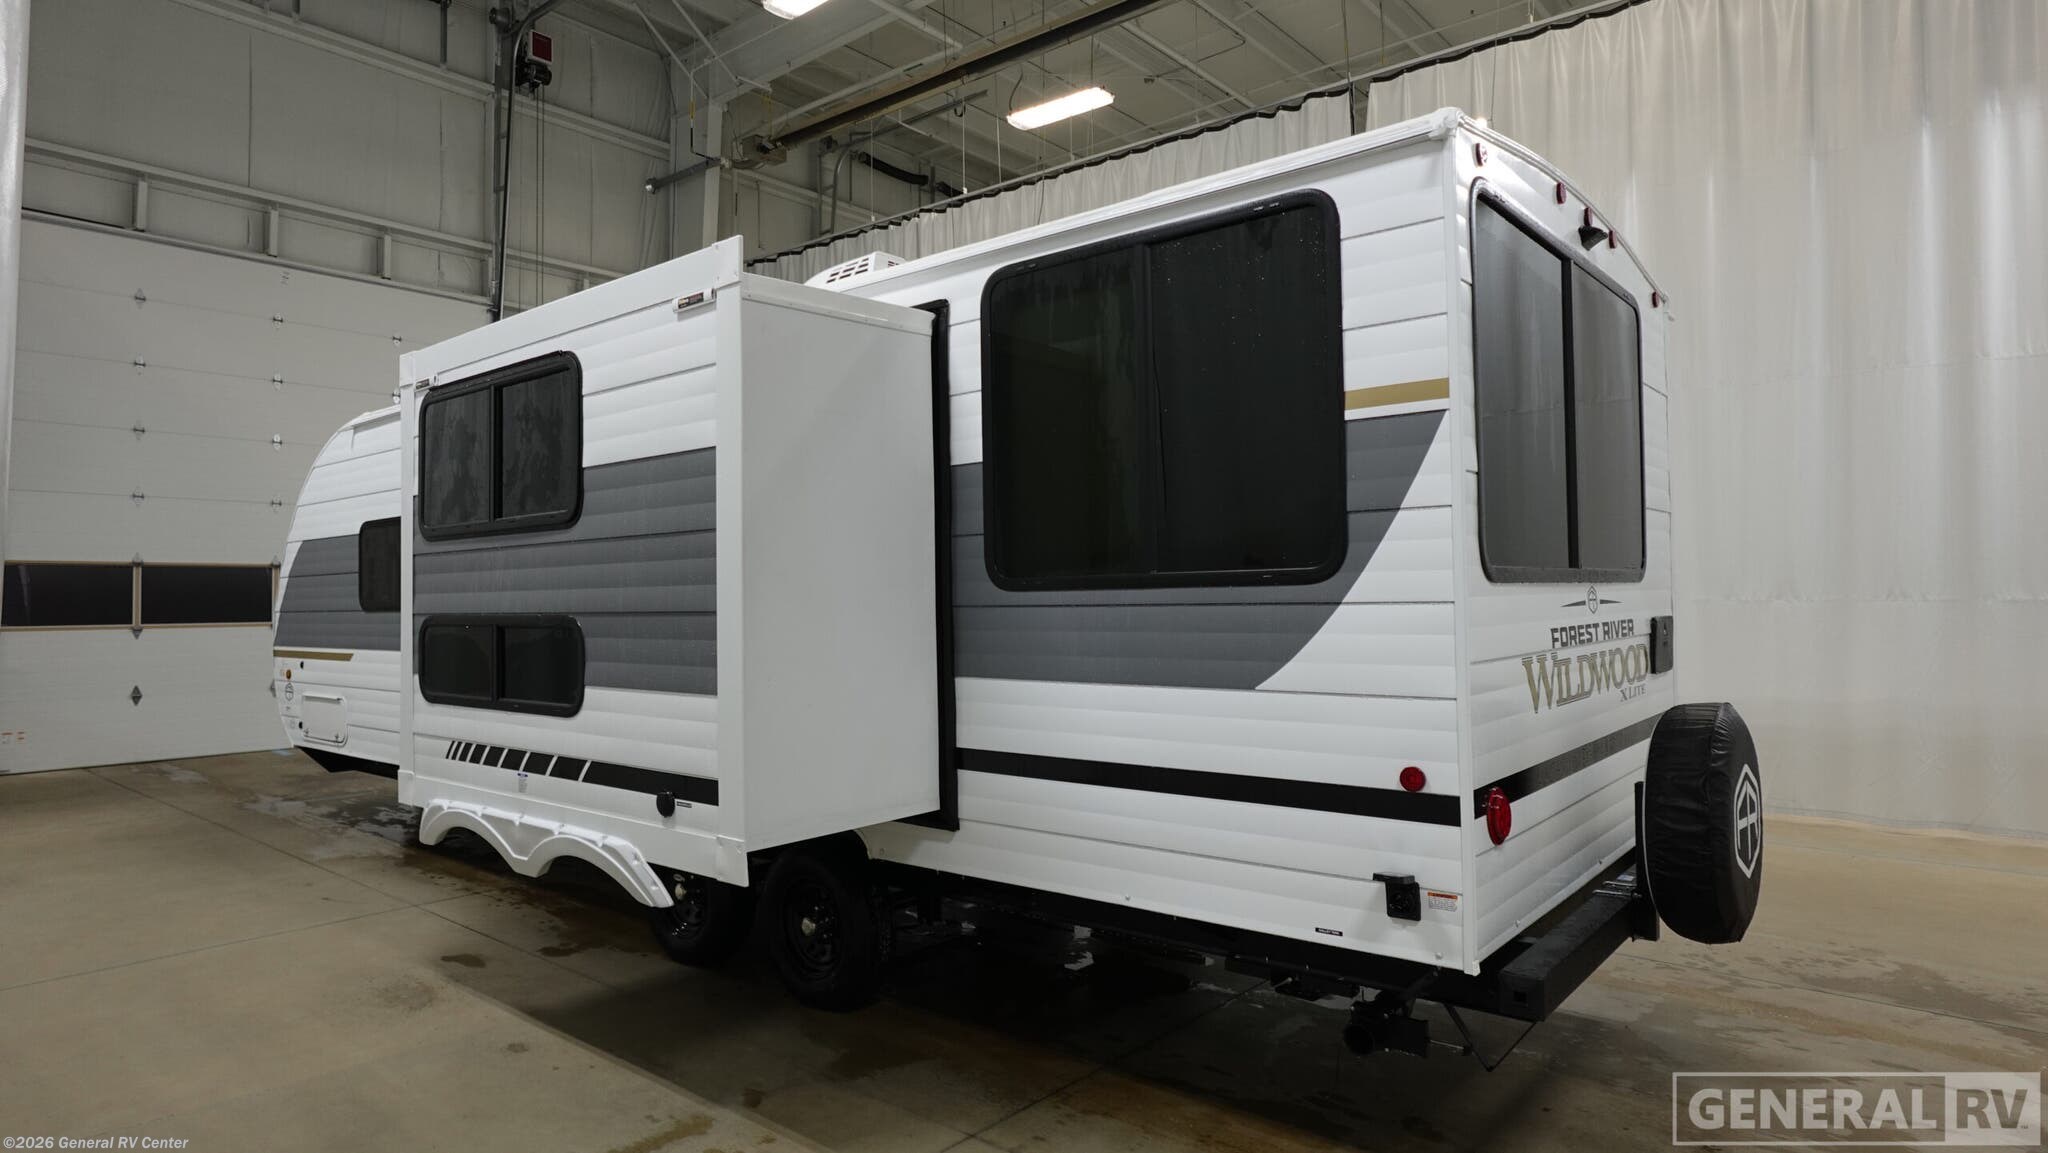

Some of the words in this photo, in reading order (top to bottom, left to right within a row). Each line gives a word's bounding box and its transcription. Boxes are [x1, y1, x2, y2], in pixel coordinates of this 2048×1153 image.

[1550, 622, 1600, 649] FOREST
[1602, 619, 1634, 640] RIVER
[1522, 644, 1649, 714] WILDWOOD
